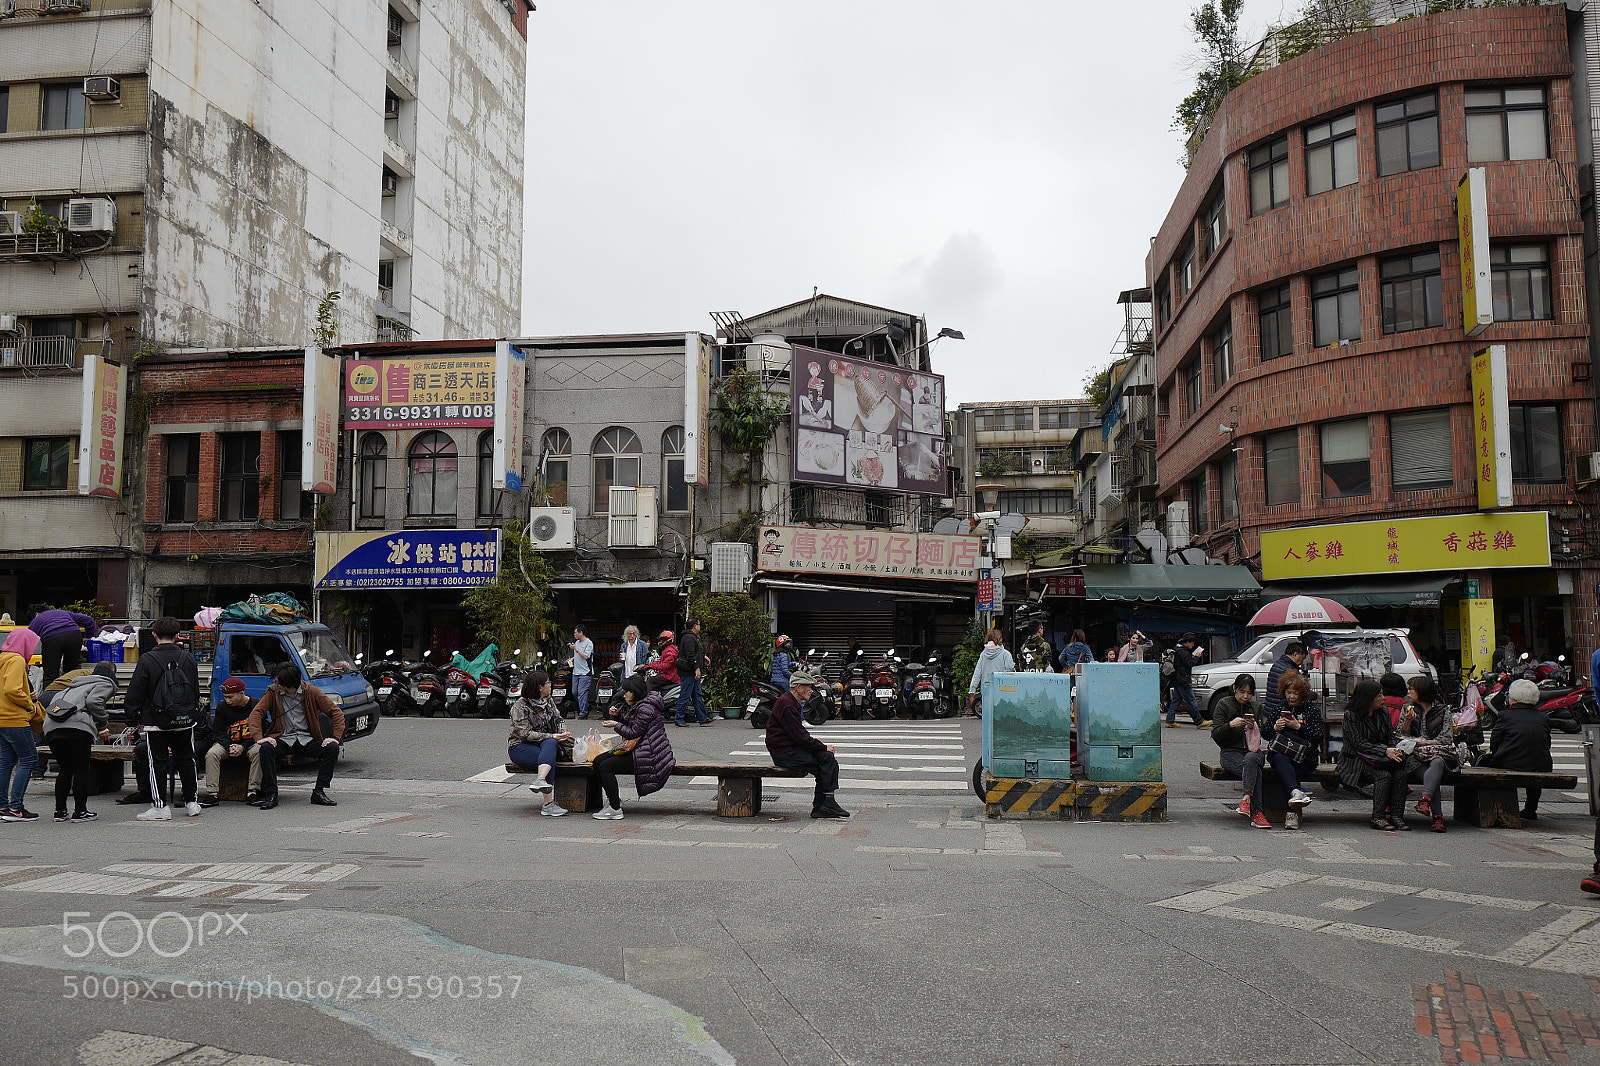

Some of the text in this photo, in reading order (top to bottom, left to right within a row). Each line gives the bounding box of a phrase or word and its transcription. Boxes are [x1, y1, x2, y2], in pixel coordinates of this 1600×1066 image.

[386, 363, 411, 404] 售
[426, 391, 458, 403] 31.46
[350, 405, 441, 421] 3316-9931
[461, 404, 494, 418] 008
[386, 538, 458, 565] 冰供站
[790, 531, 979, 568] 傳統切仔麵店
[1386, 526, 1400, 565] 龍城號
[1442, 530, 1517, 553] 香菇雞
[1291, 611, 1323, 620] SAMPO
